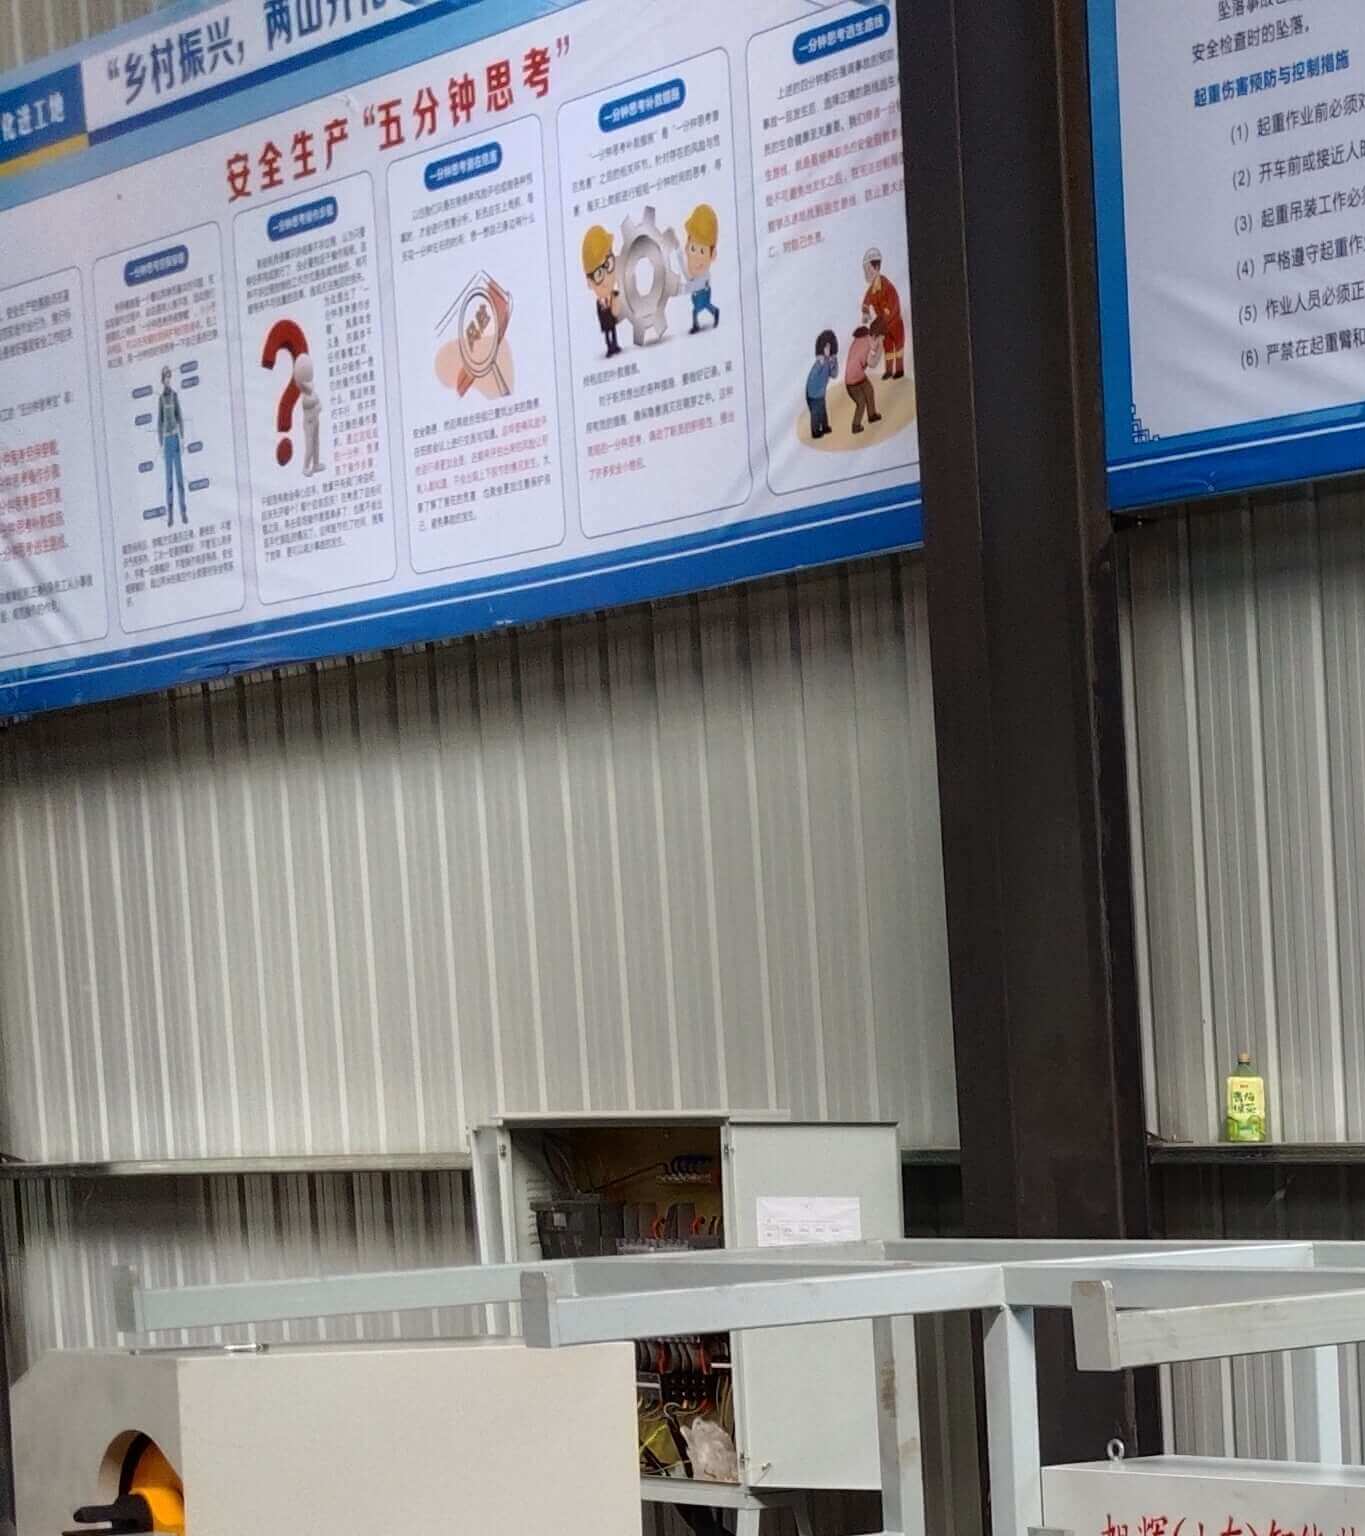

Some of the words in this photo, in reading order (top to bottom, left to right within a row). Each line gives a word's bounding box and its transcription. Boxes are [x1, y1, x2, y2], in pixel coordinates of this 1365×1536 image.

[1193, 49, 1350, 108] 起重伤害预防与控制措施
